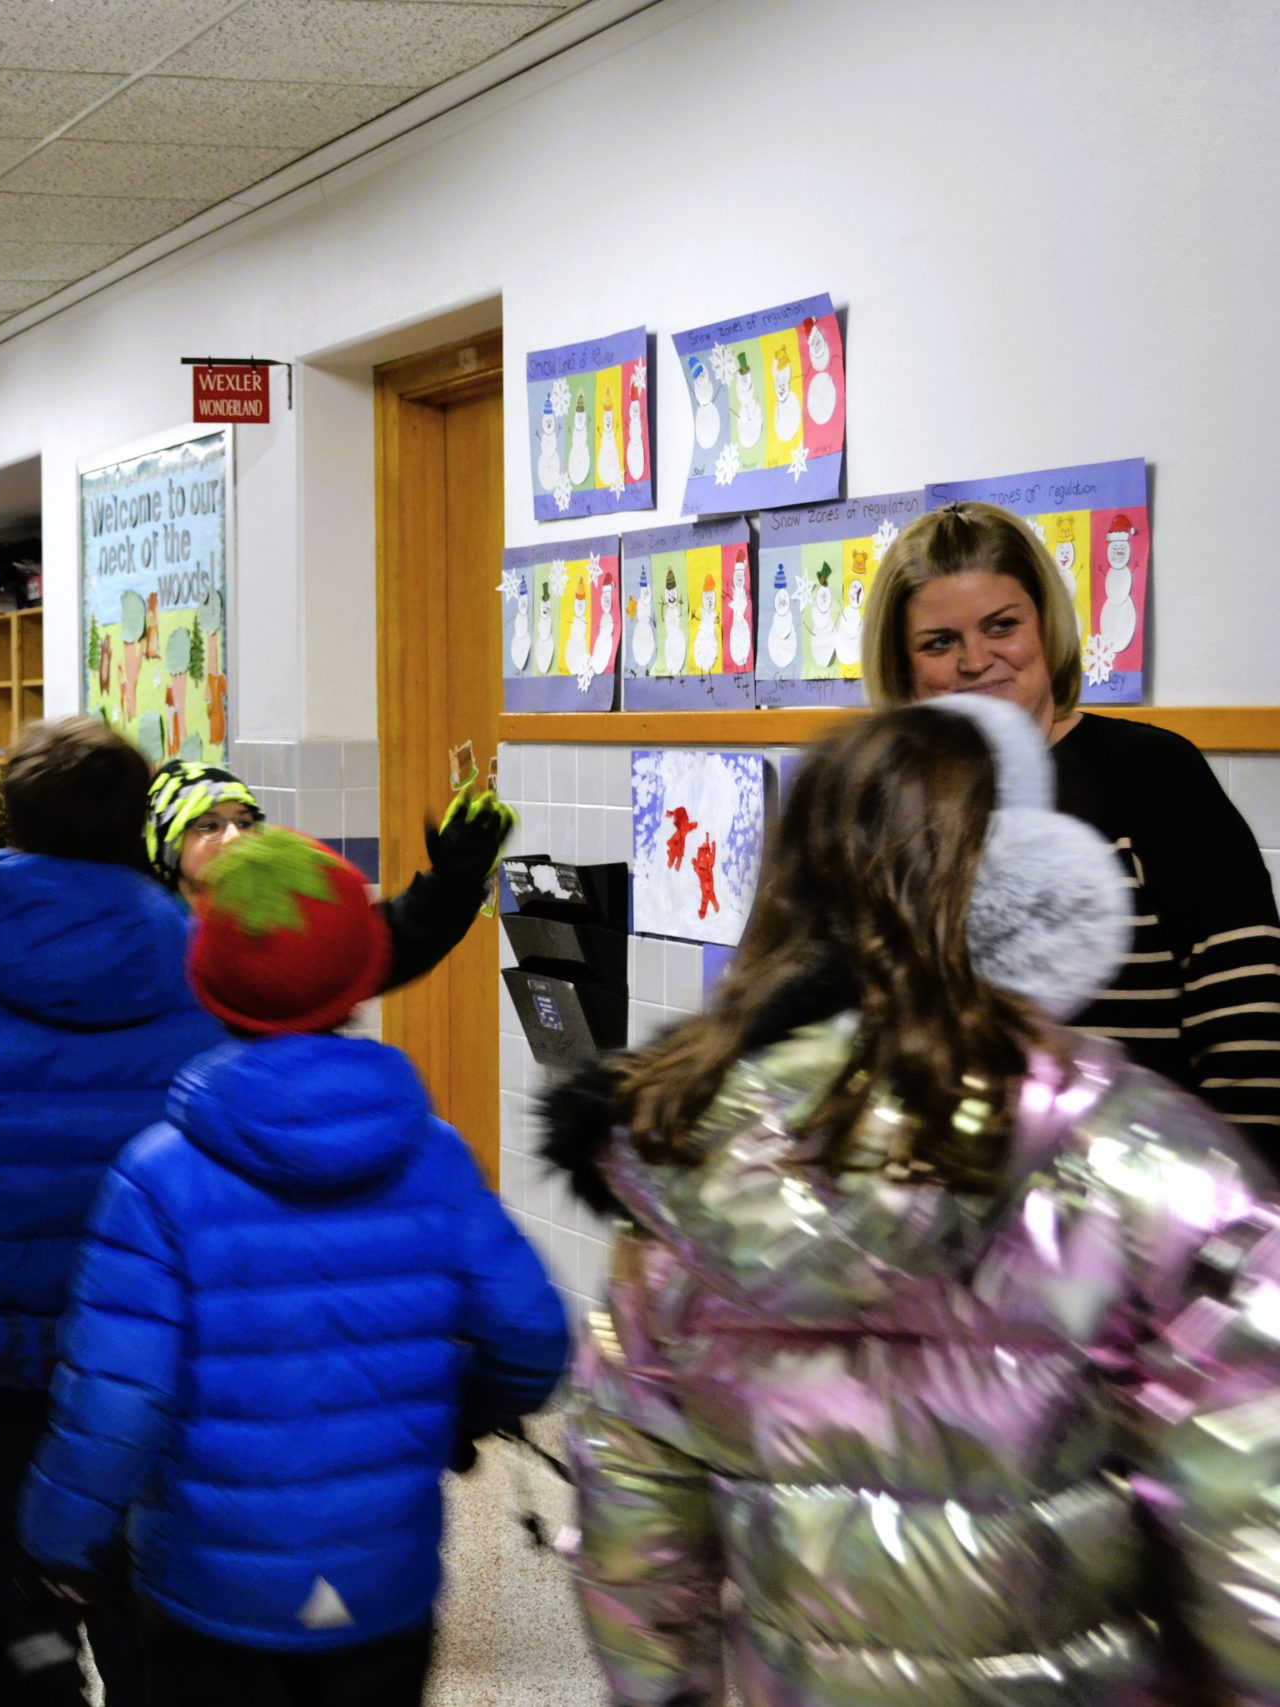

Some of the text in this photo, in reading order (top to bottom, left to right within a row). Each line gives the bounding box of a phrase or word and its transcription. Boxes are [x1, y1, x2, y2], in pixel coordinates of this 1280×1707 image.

[688, 332, 712, 346] Snow
[747, 314, 757, 330] of
[198, 373, 263, 391] WEXLER
[198, 398, 263, 417] WONDERLAND
[90, 477, 219, 538] Welcome to our
[1048, 480, 1097, 506] regulation
[771, 510, 801, 531] Snow
[846, 499, 860, 520] of
[863, 497, 919, 523] regulation
[99, 522, 192, 576] neck of the
